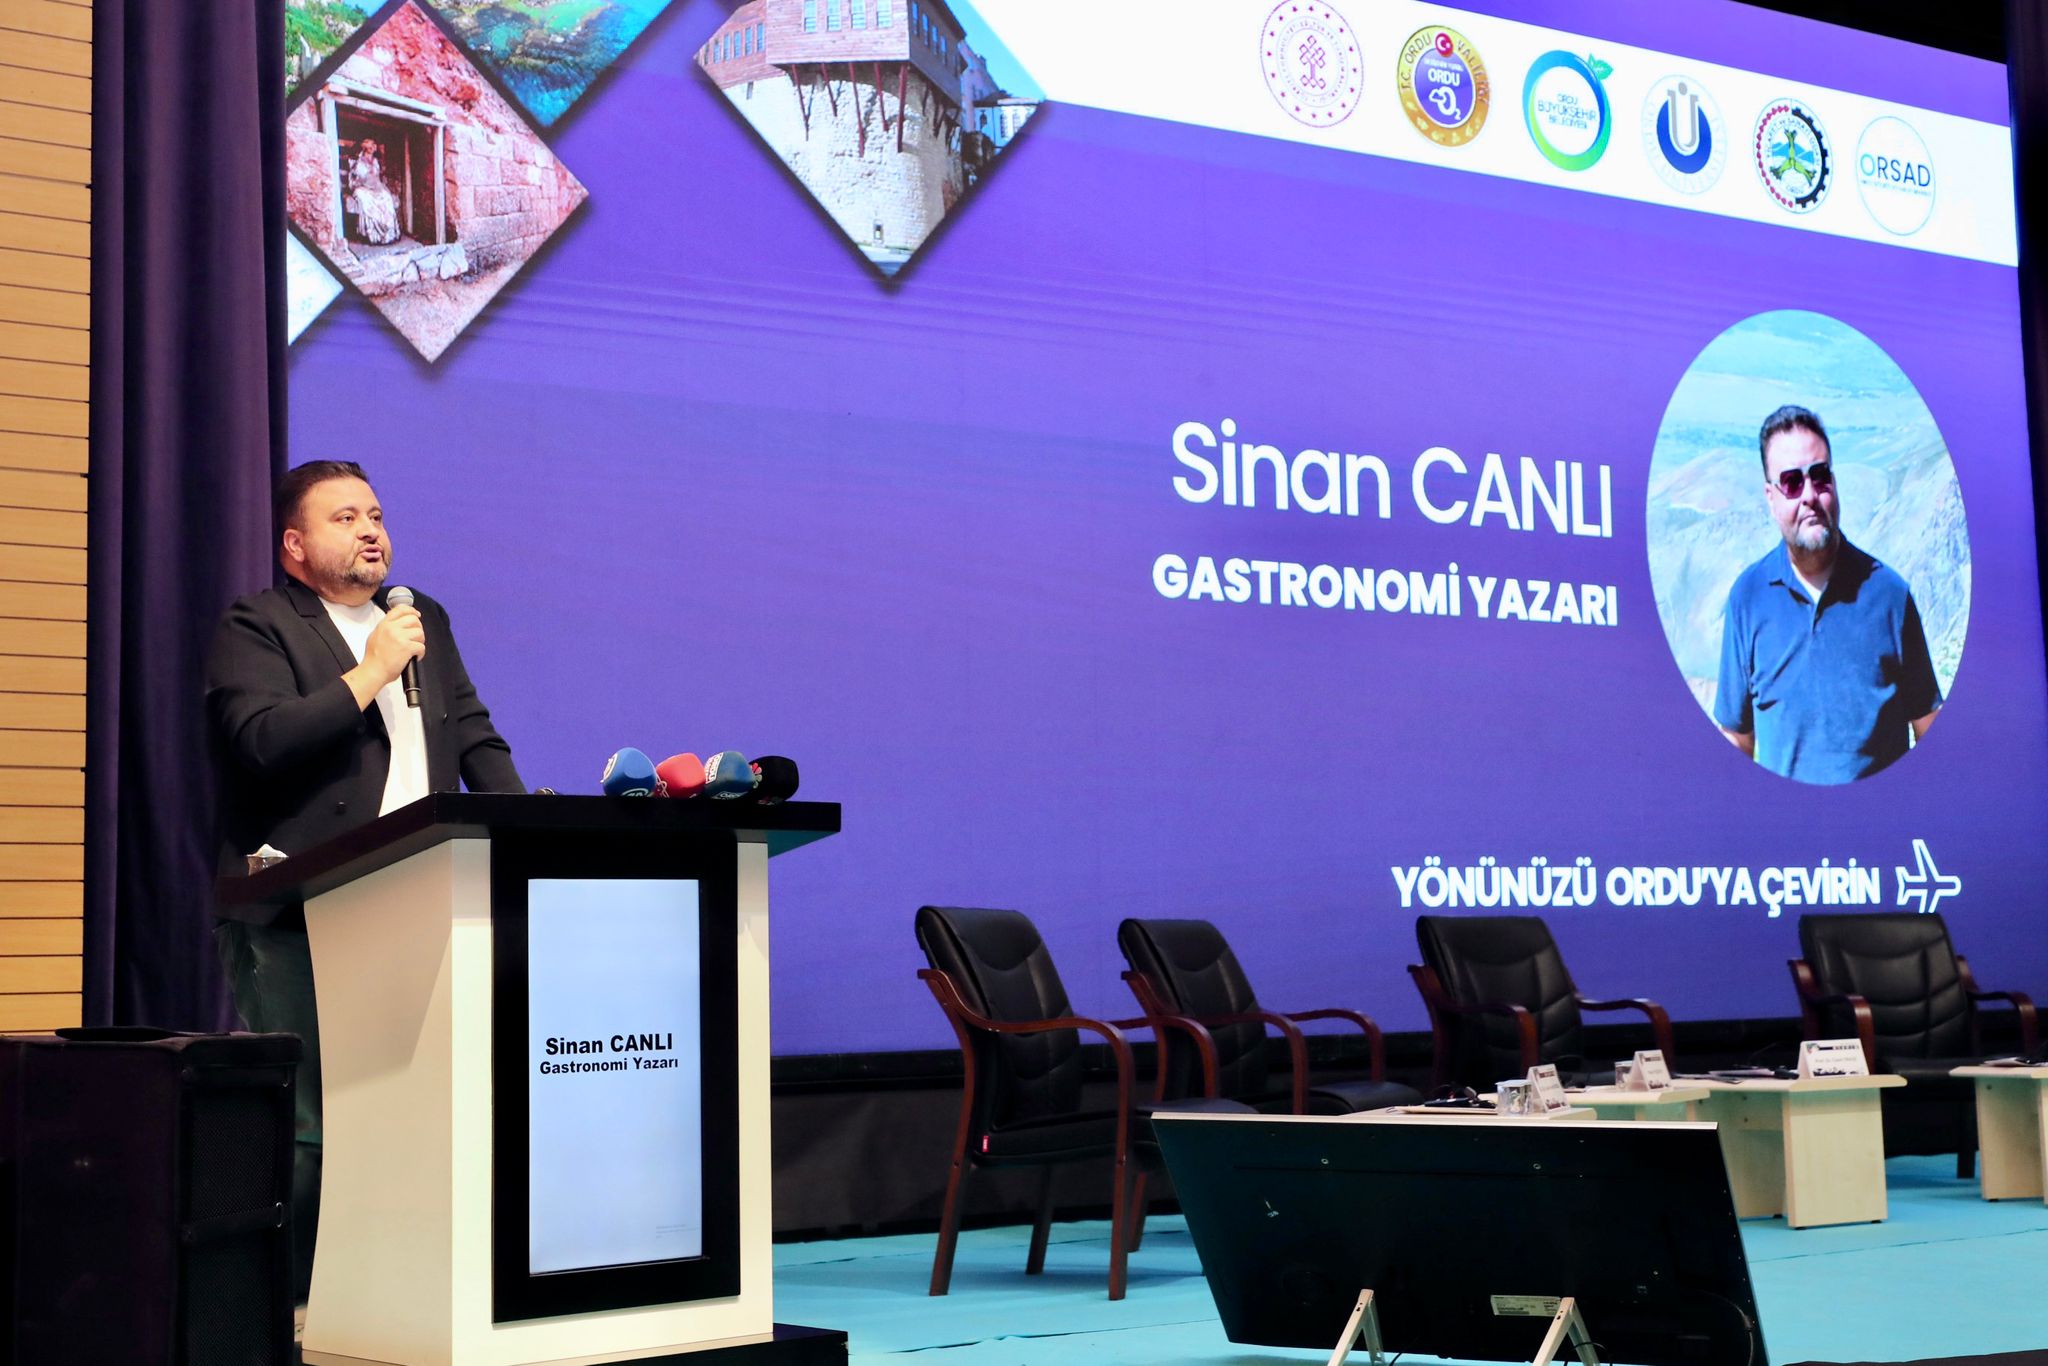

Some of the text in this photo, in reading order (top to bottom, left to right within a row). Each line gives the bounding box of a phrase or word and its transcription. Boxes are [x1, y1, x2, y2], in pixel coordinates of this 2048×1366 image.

[1405, 32, 1432, 64] ORDU
[1427, 68, 1461, 87] ORDU
[1860, 153, 1931, 187] ORSAD
[1172, 417, 1613, 538] Sinan CANLI
[1152, 553, 1618, 626] GASTRONOMİ YAZARI
[1391, 856, 1881, 918] YÖNÜNÜZÜ ORDU'YA ÇEVİRİN
[545, 1033, 673, 1055] Sinan CANLI
[539, 1056, 679, 1075] Gastronomi Yazarı
